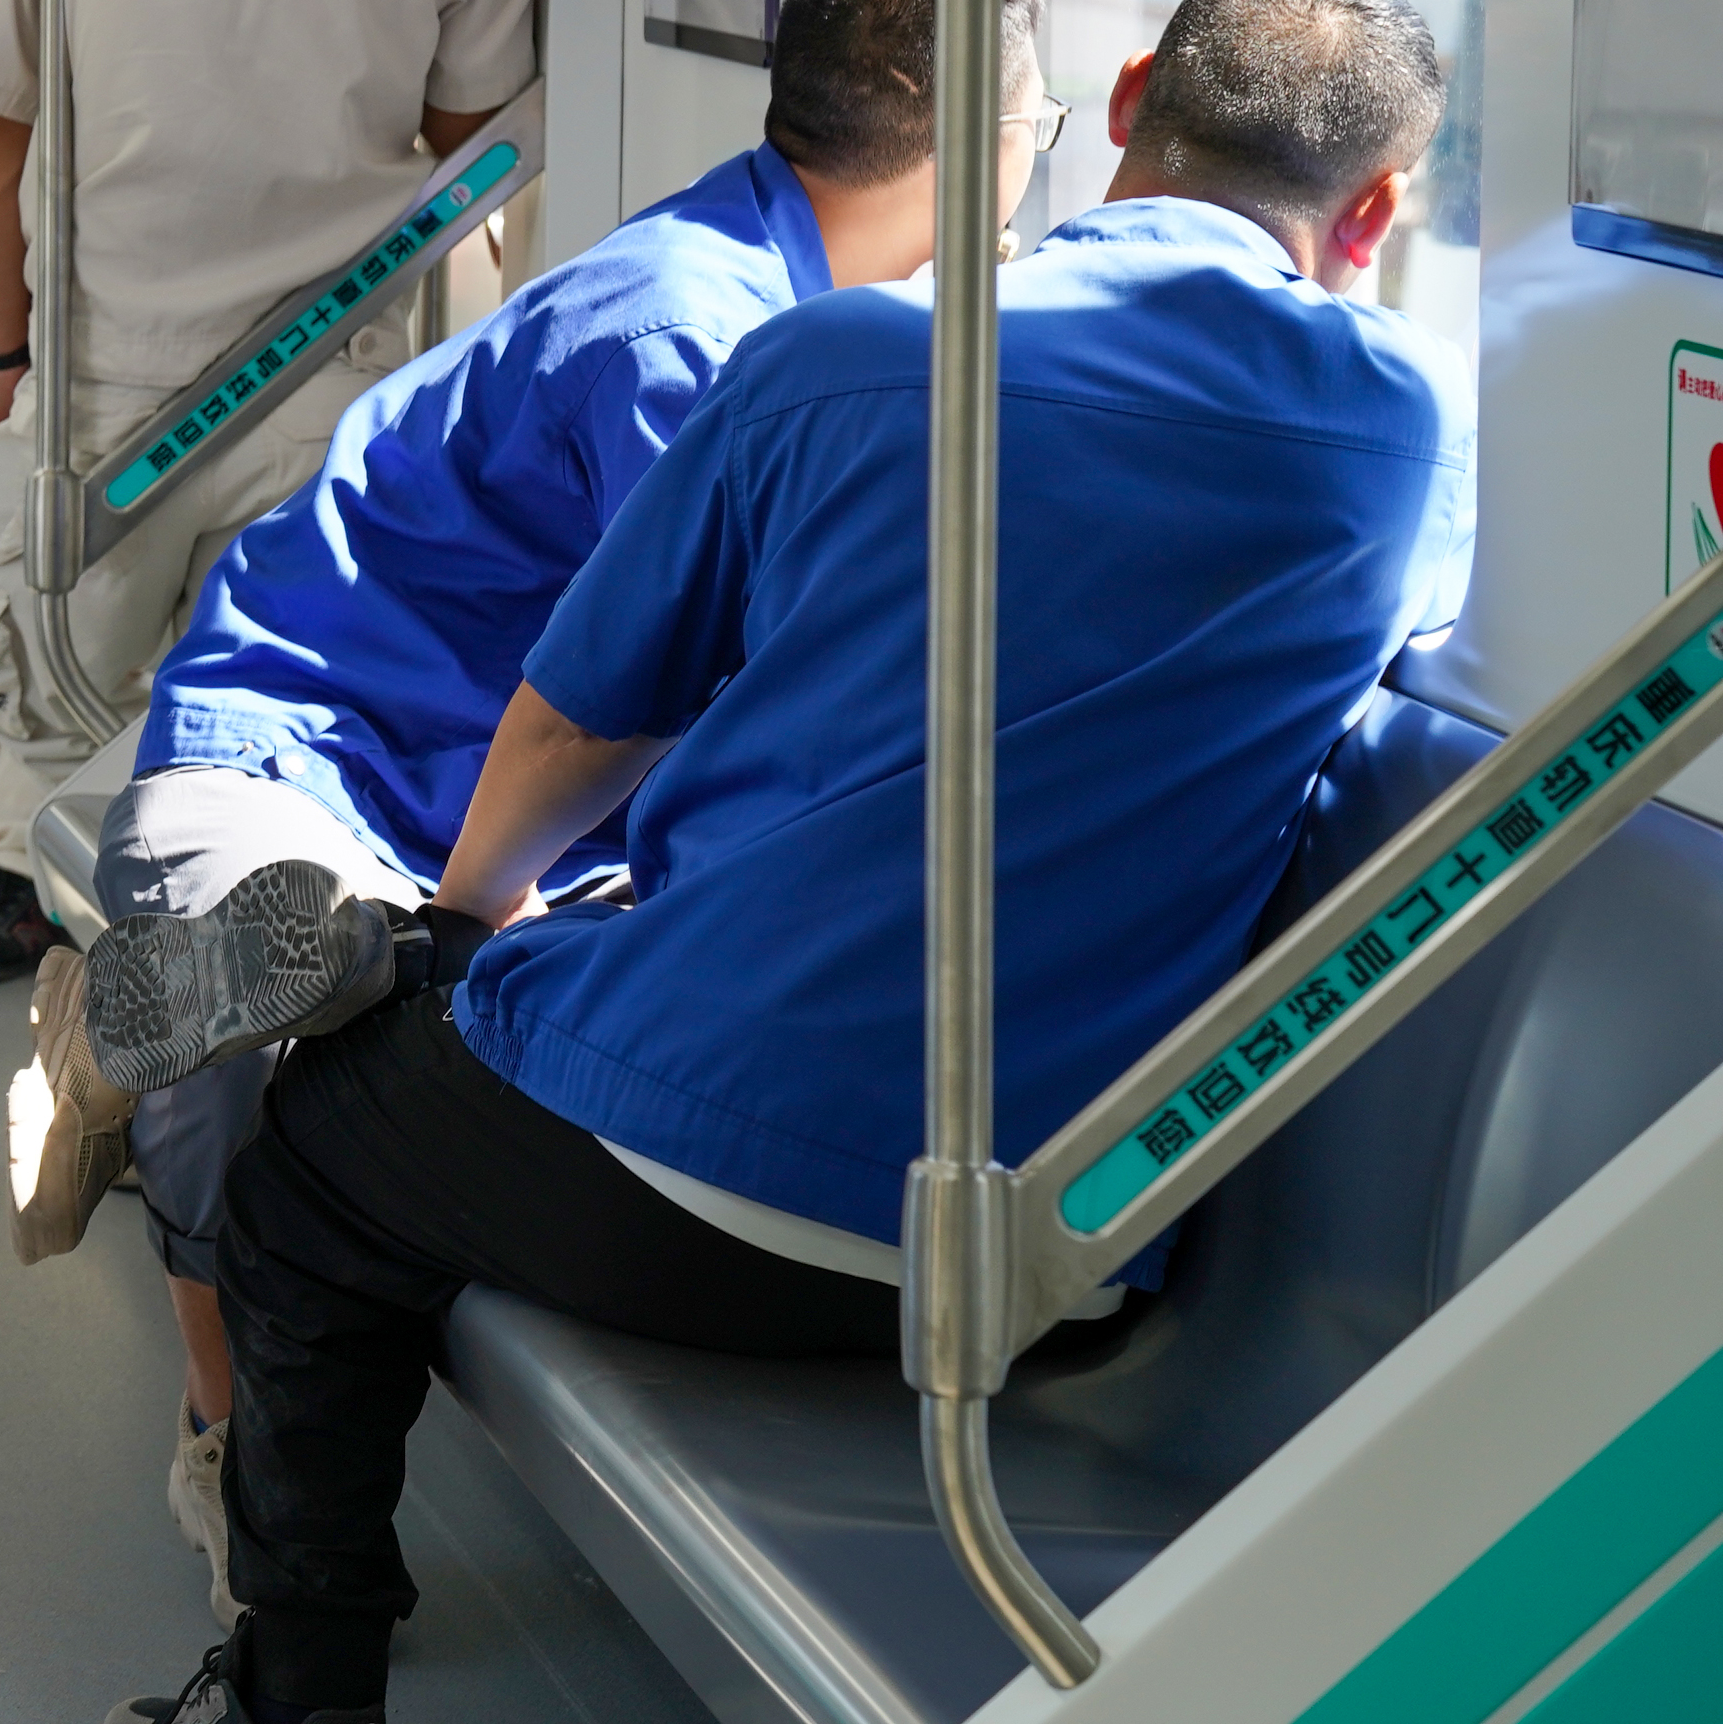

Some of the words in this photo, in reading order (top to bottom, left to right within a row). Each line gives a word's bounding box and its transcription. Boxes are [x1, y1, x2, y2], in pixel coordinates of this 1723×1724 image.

[146, 208, 444, 473] 重庆轨道十八号线欢迎您
[1137, 666, 1697, 1165] 重庆轨道十八号线欢迎您
